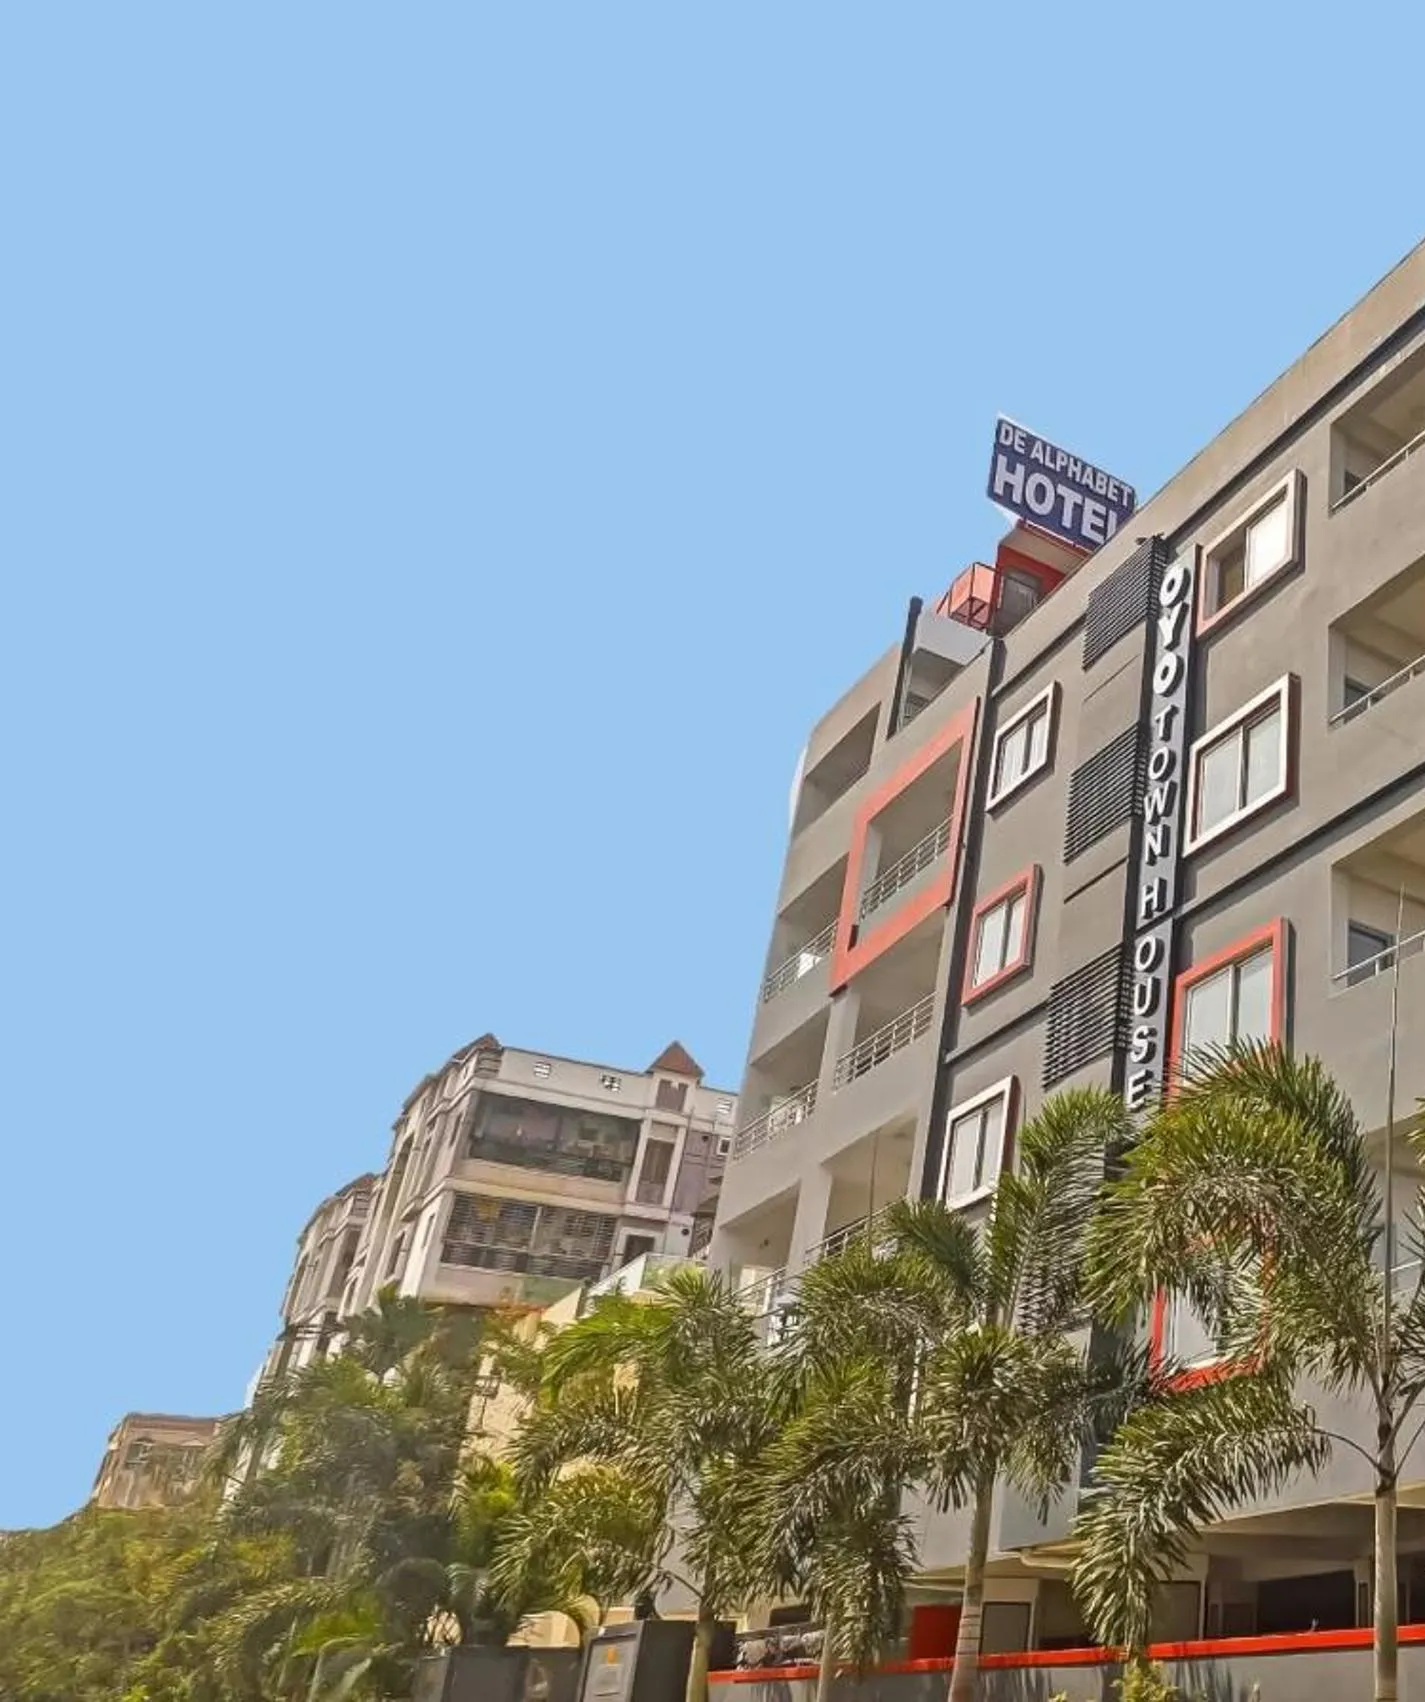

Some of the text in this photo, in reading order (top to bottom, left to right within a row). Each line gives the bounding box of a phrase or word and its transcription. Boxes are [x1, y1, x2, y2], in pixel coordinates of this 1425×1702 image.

[1000, 422, 1132, 506] DE ALPHABET
[1153, 564, 1190, 697] OYO
